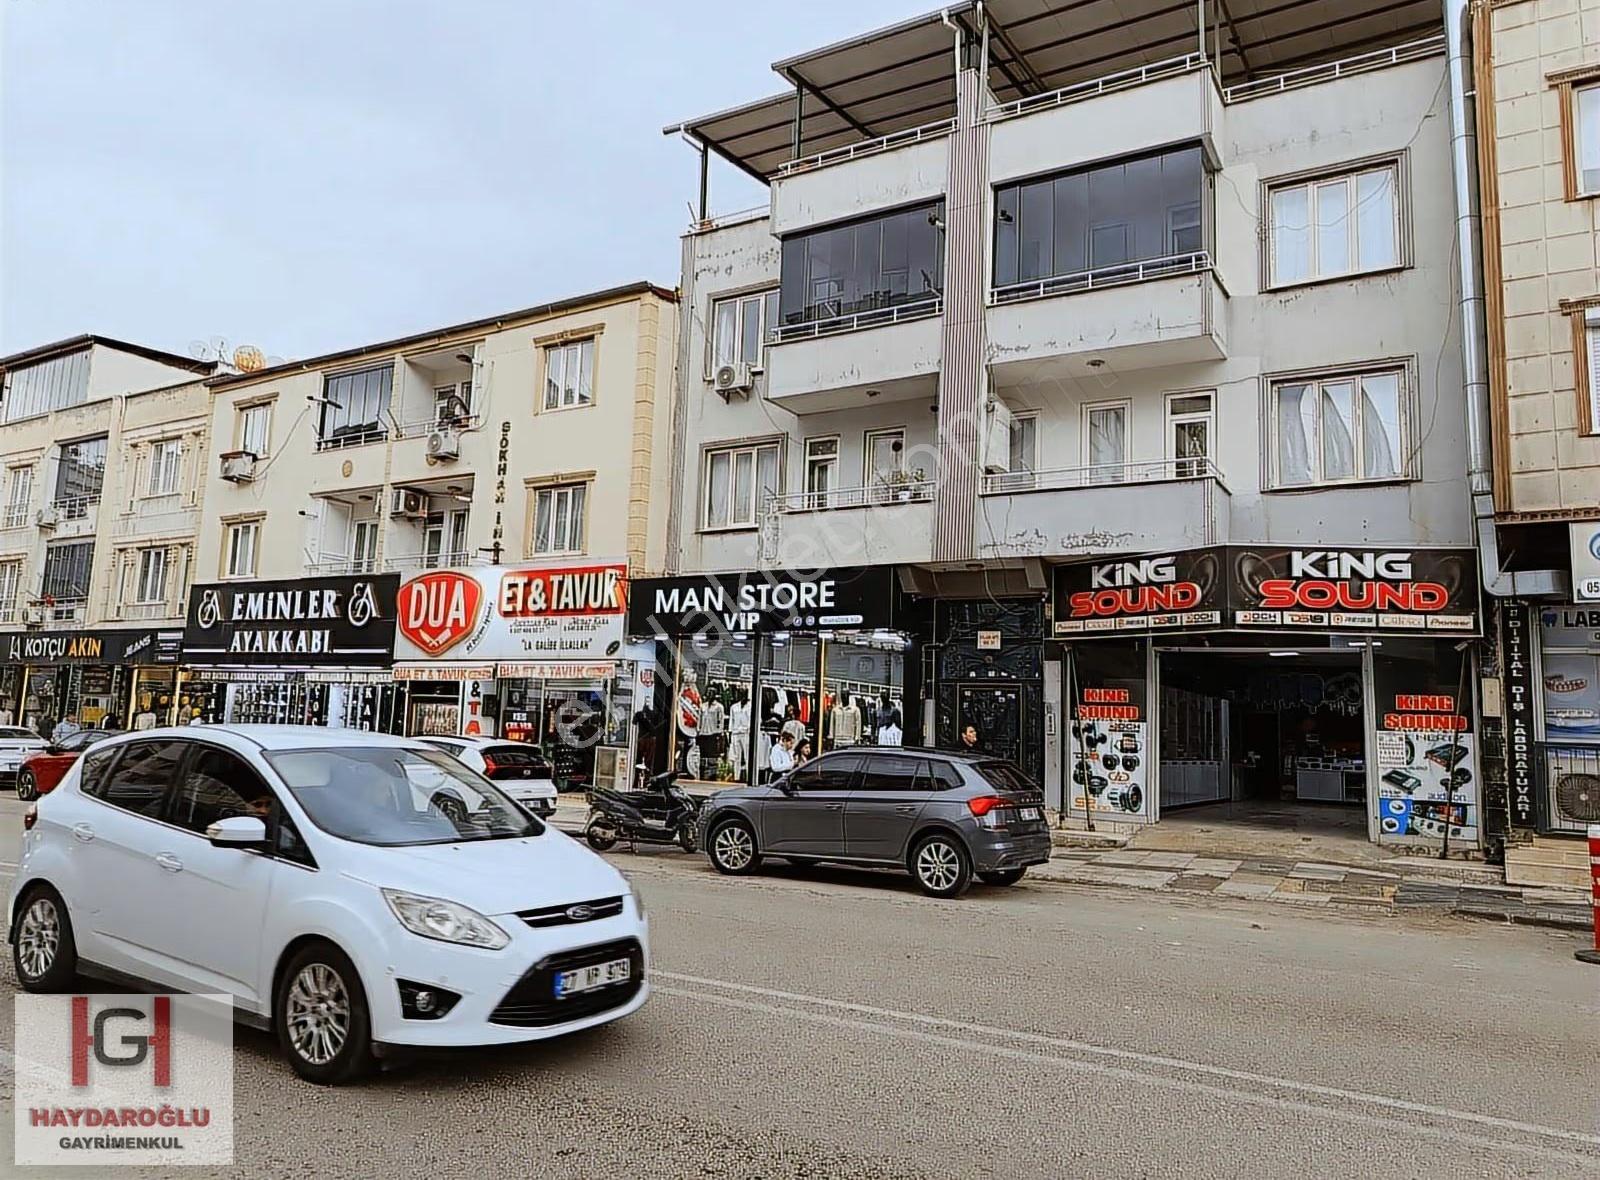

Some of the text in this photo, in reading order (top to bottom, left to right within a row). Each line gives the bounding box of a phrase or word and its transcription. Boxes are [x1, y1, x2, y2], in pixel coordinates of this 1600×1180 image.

[408, 580, 466, 629] DUA
[502, 570, 618, 612] ET & TAVUK
[655, 581, 835, 614] MAN STORE
[1070, 581, 1202, 618] SOUND
[1258, 579, 1449, 612] SOUND
[724, 612, 760, 631] VIP
[25, 637, 66, 661] KOTÇU
[230, 630, 331, 654] AYAKKABI
[1078, 705, 1139, 720] SOUND
[1384, 713, 1468, 730] SOUND
